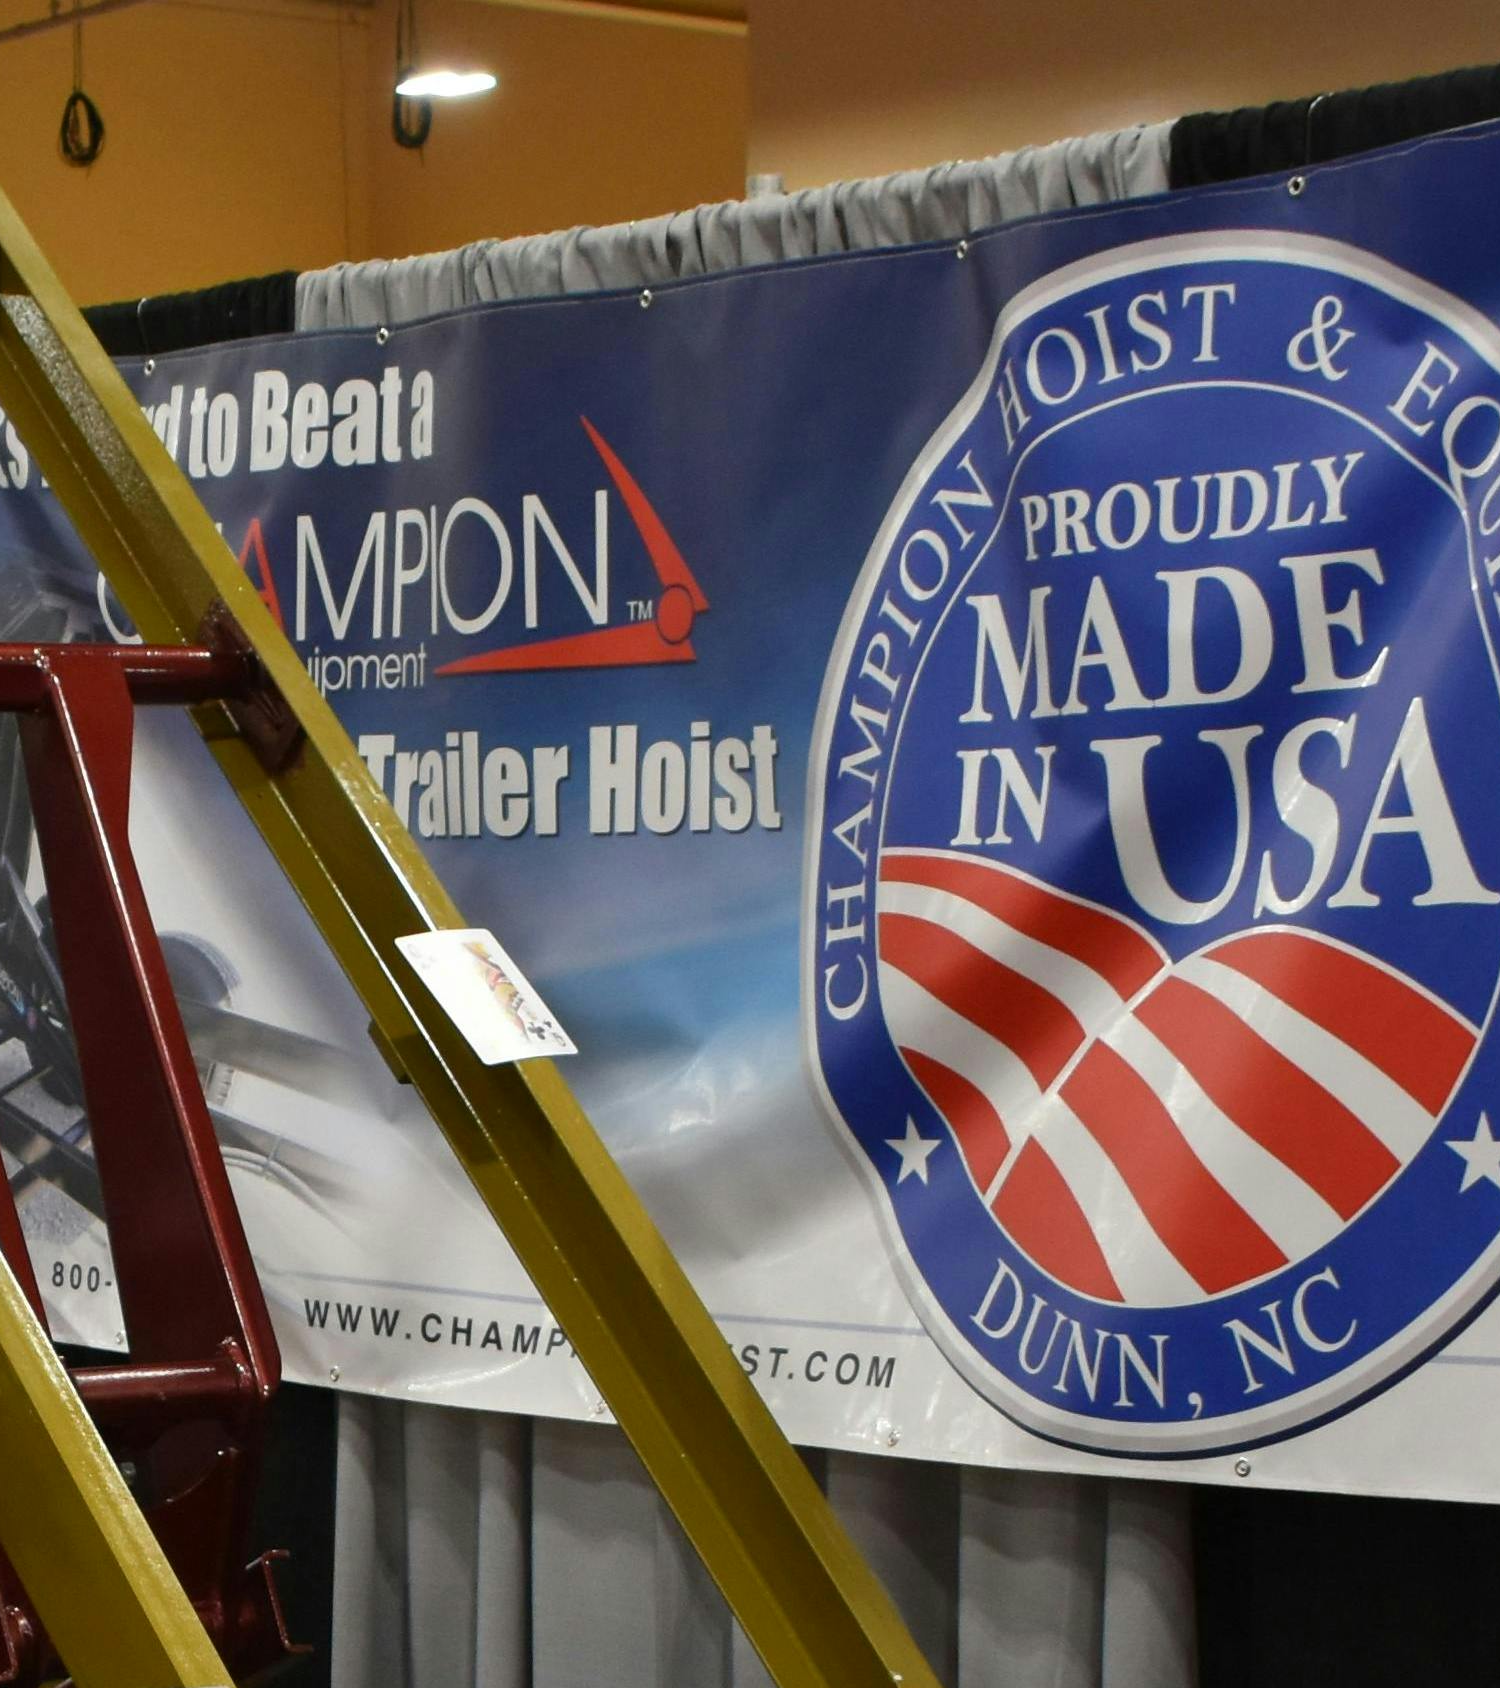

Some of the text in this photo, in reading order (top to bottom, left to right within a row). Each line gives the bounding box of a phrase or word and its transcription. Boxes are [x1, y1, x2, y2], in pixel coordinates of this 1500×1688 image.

[188, 386, 239, 479] to
[249, 366, 403, 473] Beat
[411, 370, 433, 459] a
[98, 489, 608, 646] AMPION
[1020, 451, 1364, 562] PROUDLY
[822, 452, 996, 1022] CHAMPION
[1000, 282, 1236, 440] HOIST
[1285, 294, 1356, 382] &
[958, 546, 1390, 725] MADE
[359, 722, 783, 842] Trailer Hoist
[950, 744, 1058, 848] IN
[968, 1257, 1359, 1421] DUNN, NC
